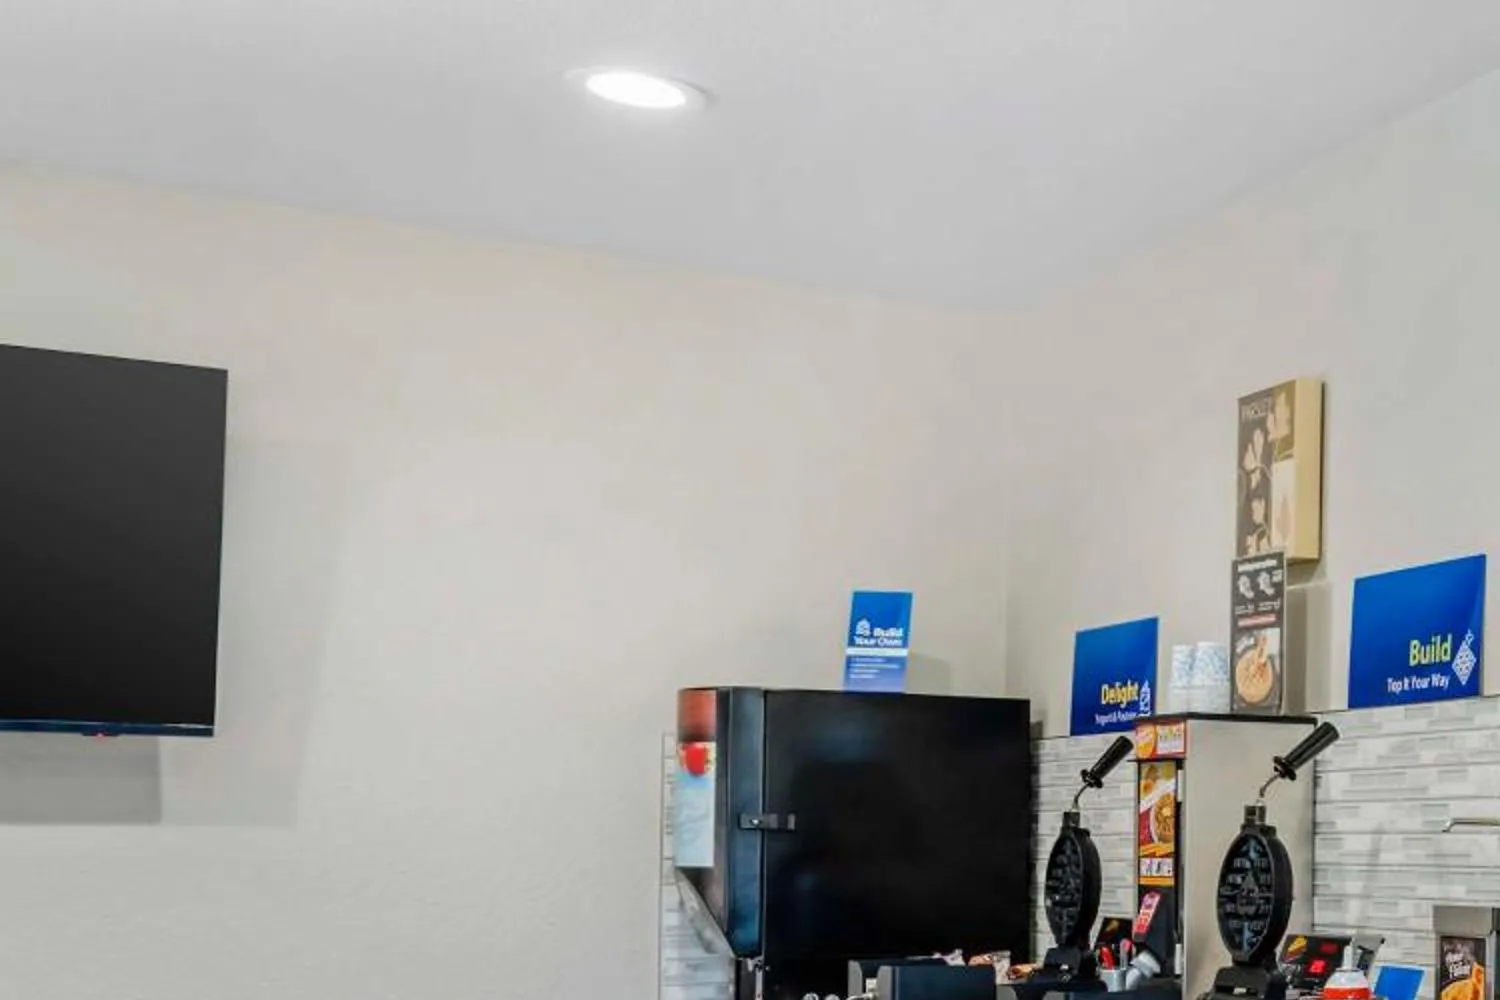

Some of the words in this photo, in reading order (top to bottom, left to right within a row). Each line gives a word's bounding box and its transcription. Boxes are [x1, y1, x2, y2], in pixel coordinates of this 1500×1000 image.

[1409, 633, 1453, 667] Build
[1101, 678, 1139, 709] Delight
[1387, 678, 1402, 695] Top
[1411, 675, 1430, 689] Your
[1431, 673, 1451, 690] Way
